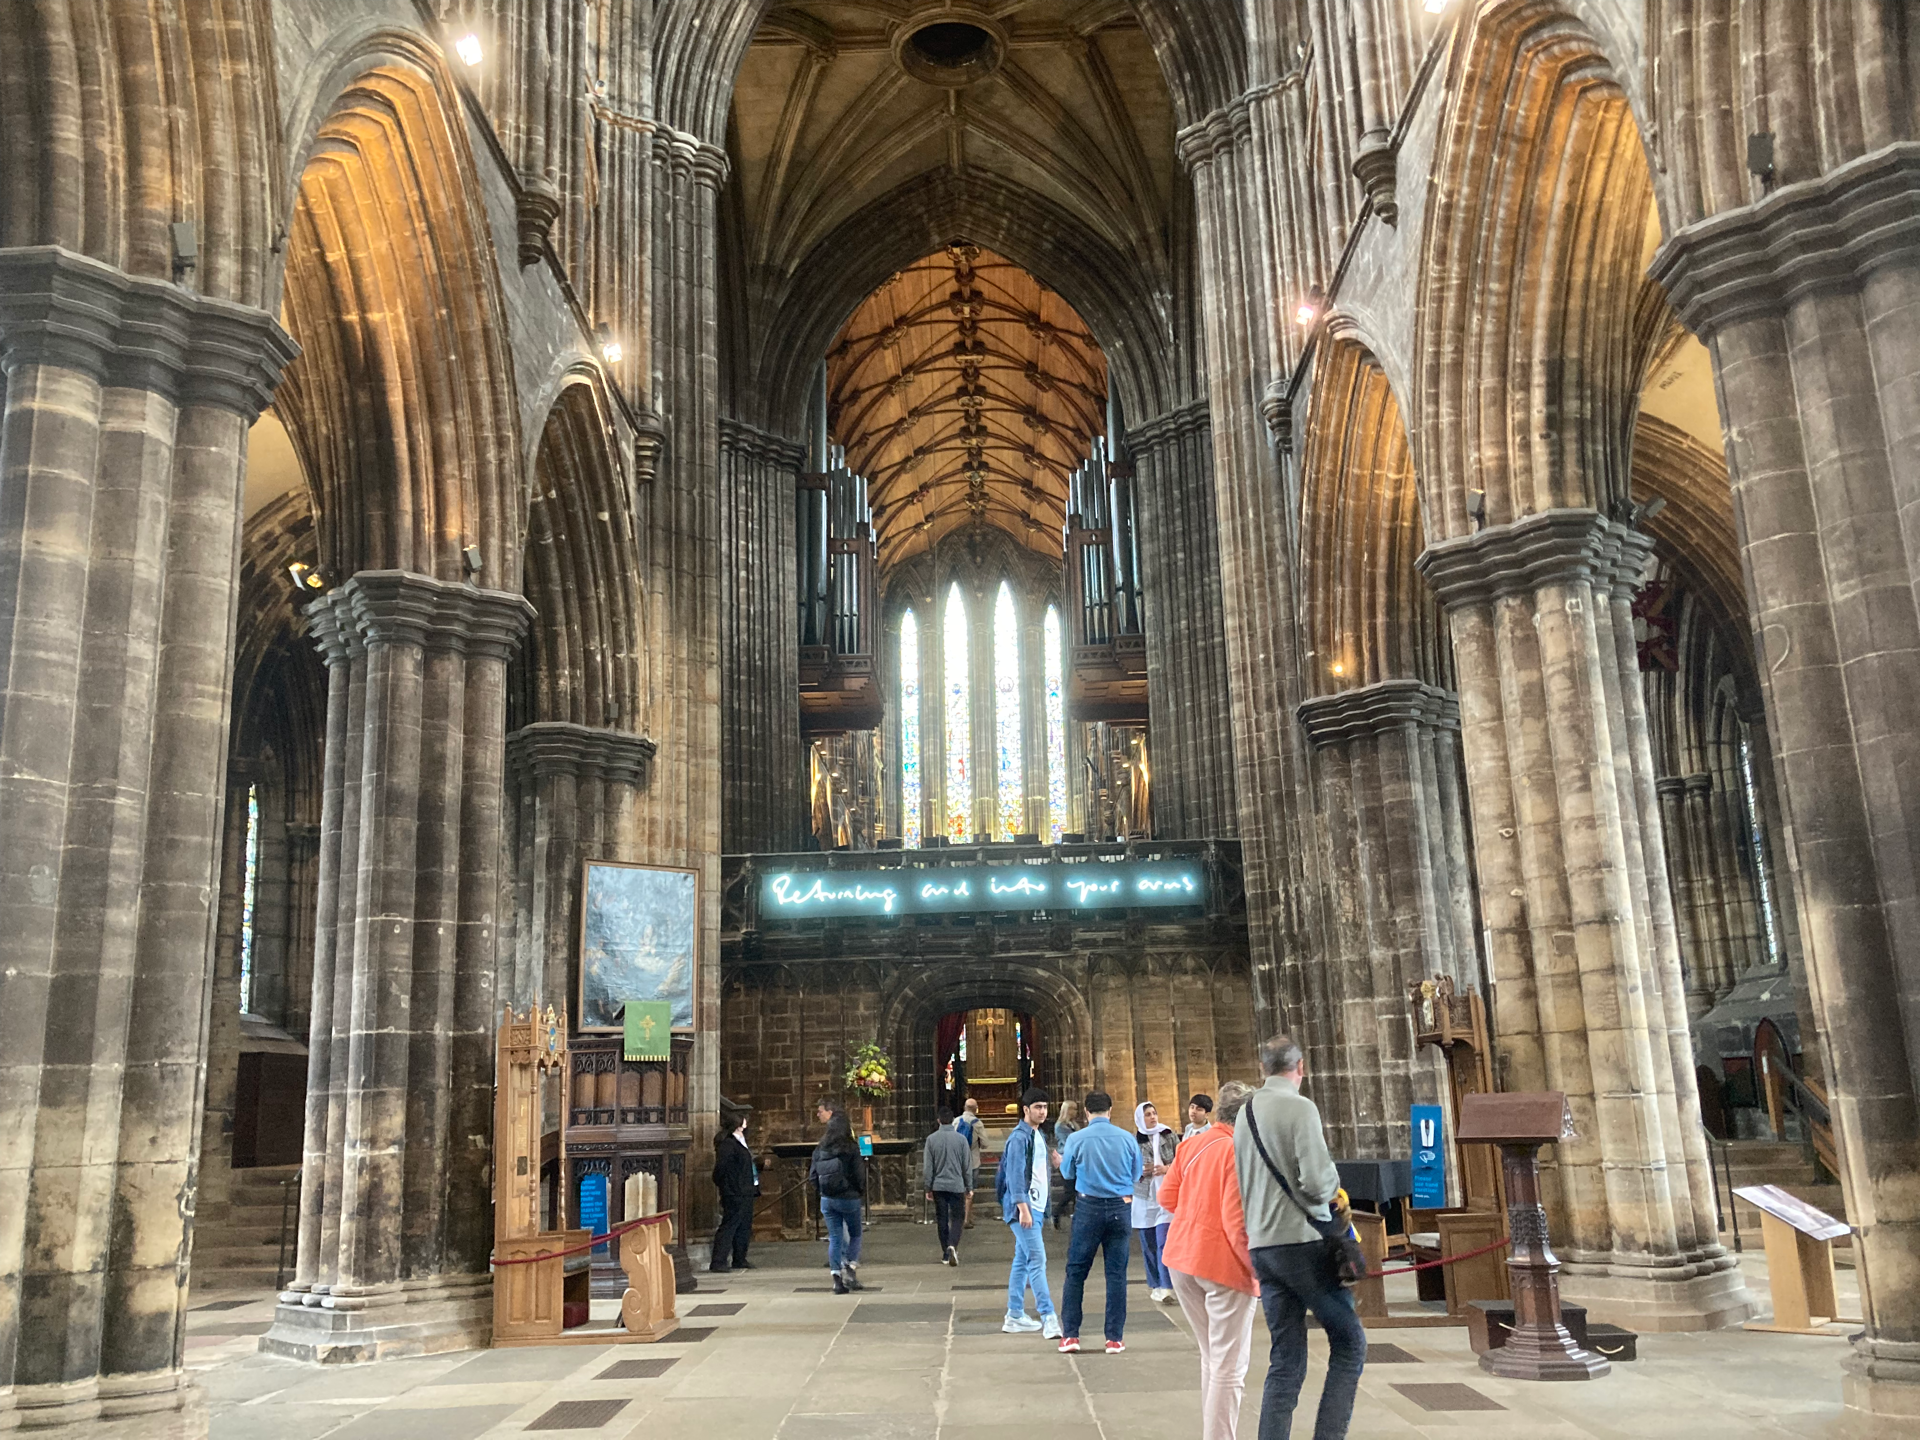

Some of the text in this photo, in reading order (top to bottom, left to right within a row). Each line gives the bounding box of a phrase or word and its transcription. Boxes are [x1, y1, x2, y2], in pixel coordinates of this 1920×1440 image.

[772, 875, 1194, 912] Returning and into your arms
